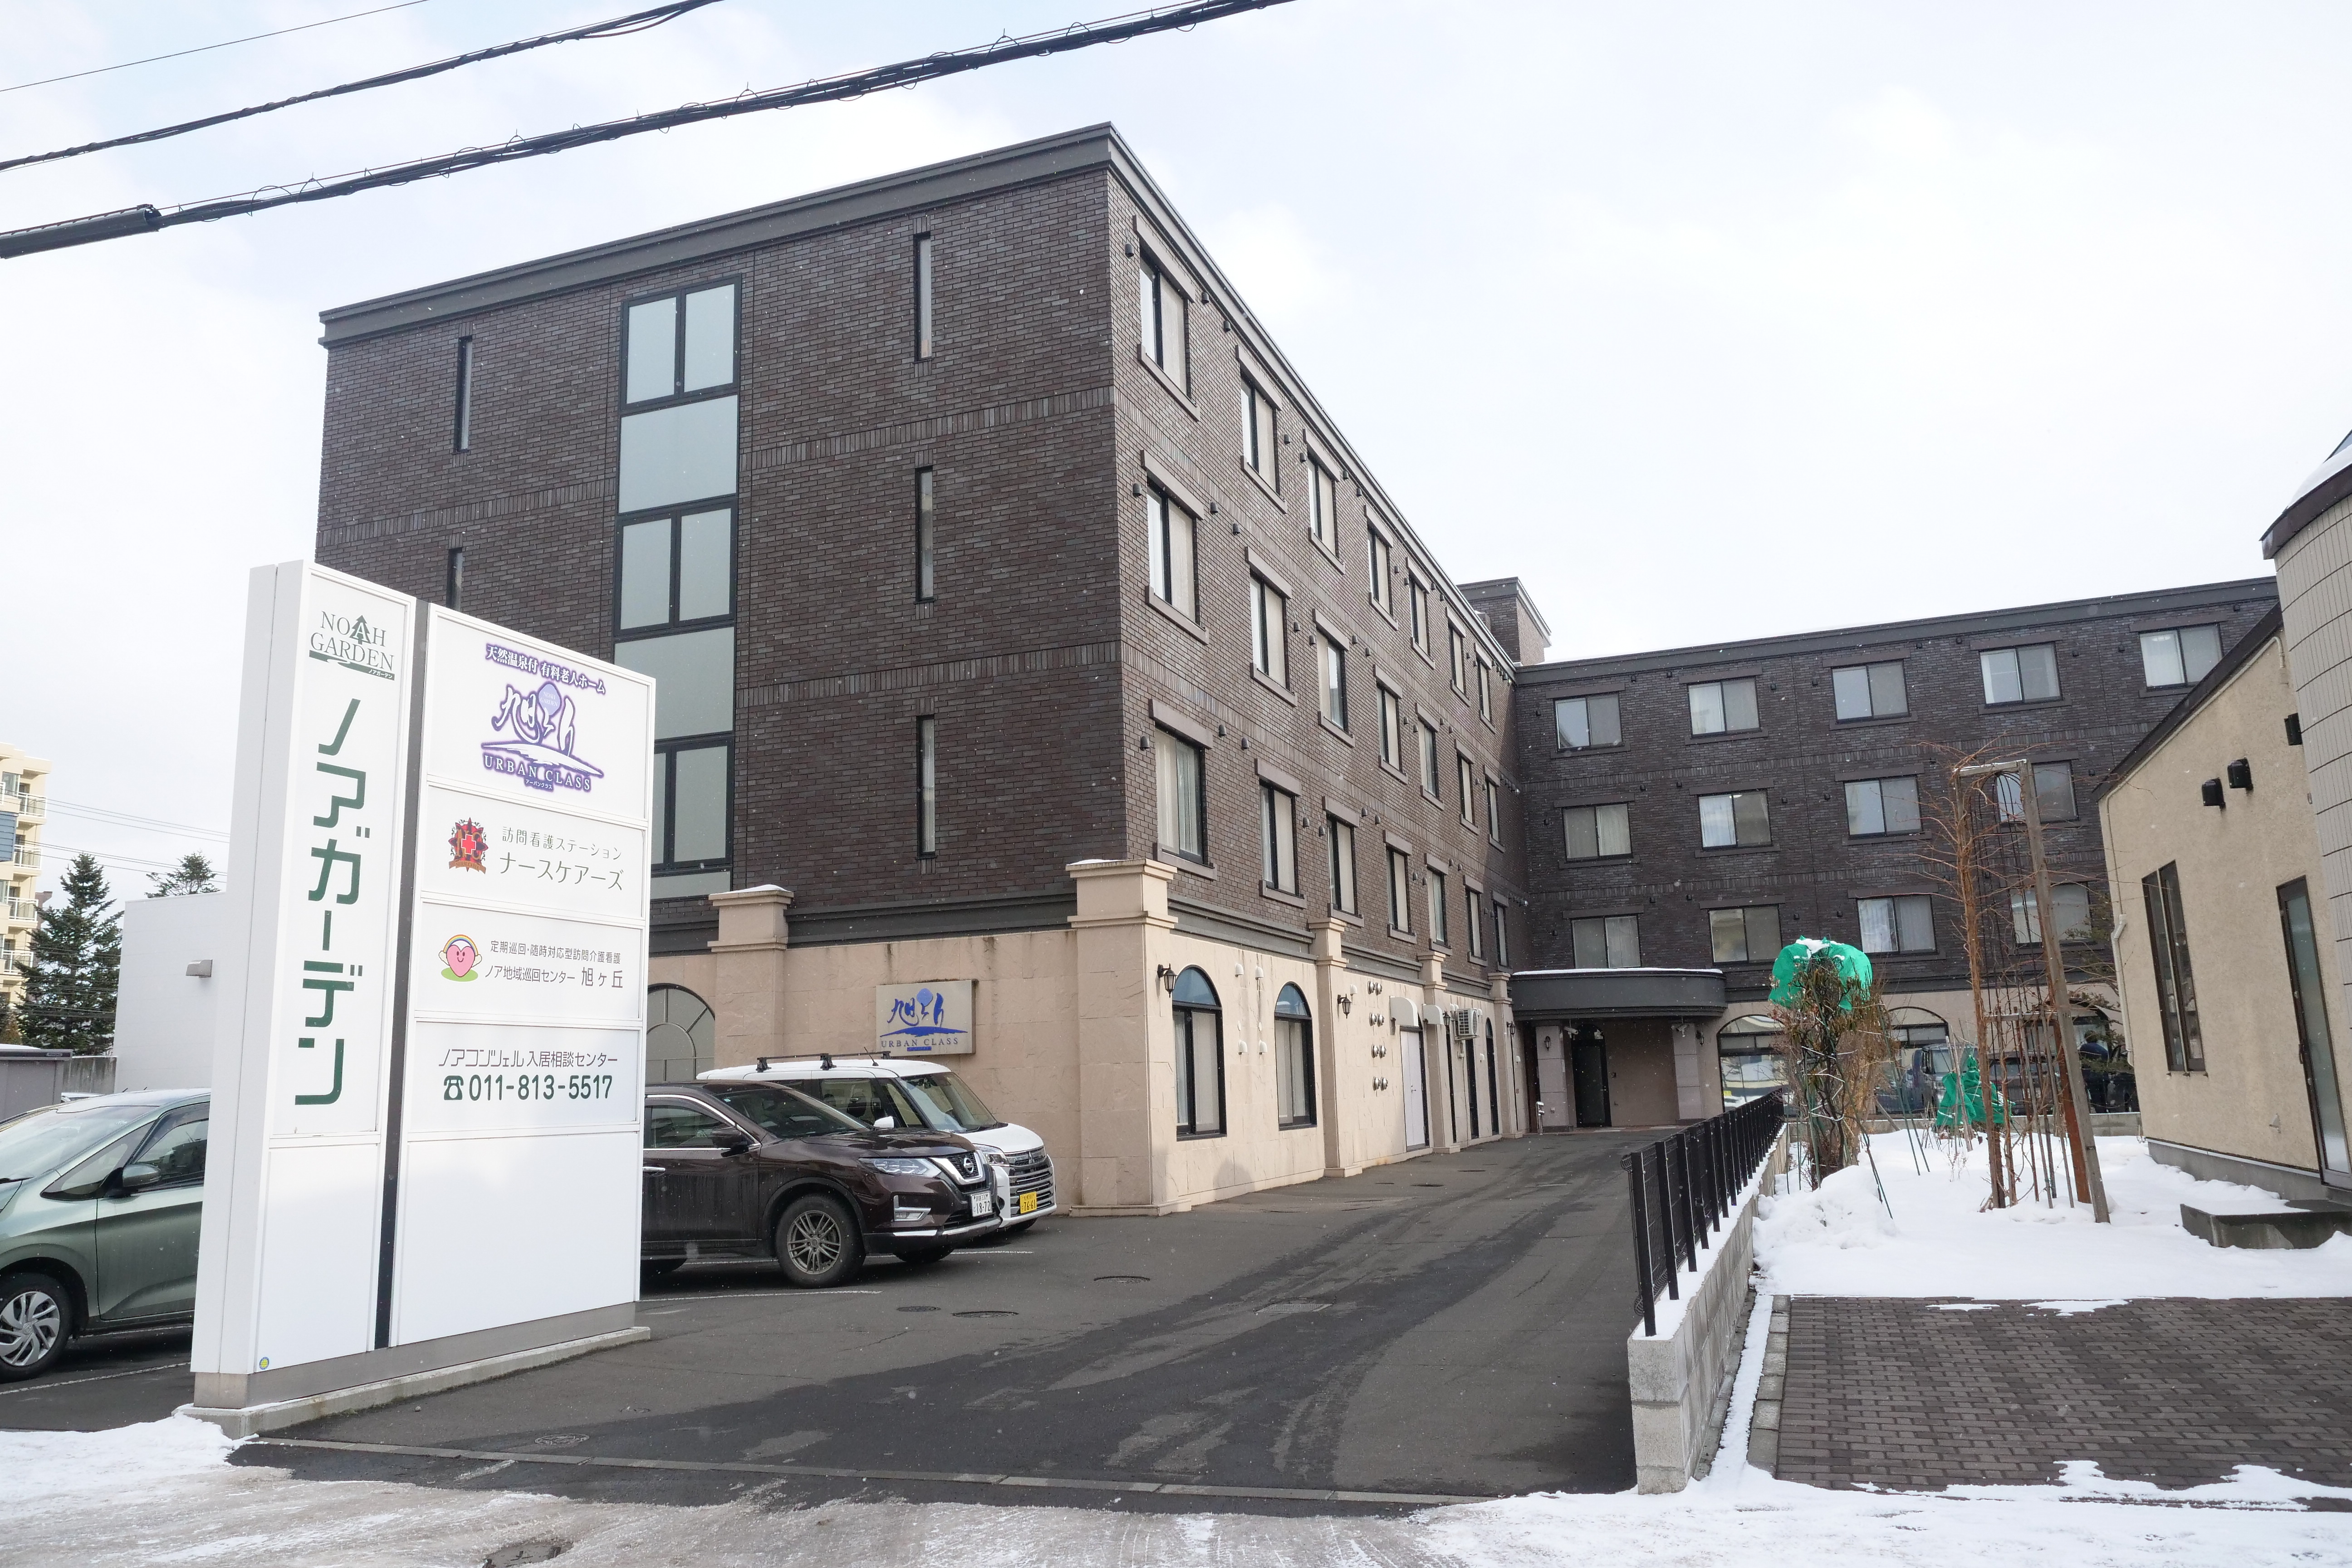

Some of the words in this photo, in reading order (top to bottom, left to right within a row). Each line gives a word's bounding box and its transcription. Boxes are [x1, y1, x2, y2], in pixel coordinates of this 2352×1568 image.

[320, 611, 386, 647] NOAH
[311, 632, 394, 671] GARDEN
[369, 669, 392, 679] ノアガーデン
[487, 646, 538, 673] 天然温泉付
[541, 663, 605, 694] 有料老人ホーム
[485, 755, 538, 778] URBAN
[545, 770, 590, 790] CLASS
[525, 779, 552, 789] アーバンクラス
[502, 826, 622, 860] 訪問看護ステーション
[500, 852, 624, 891] ナースケアーズ
[295, 698, 370, 1105] ノアガーデン
[485, 965, 575, 983] ノア地域巡回センター
[881, 1039, 918, 1048] URBAN
[924, 1037, 958, 1046] CLASS
[469, 1074, 612, 1101] 011-813-5517
